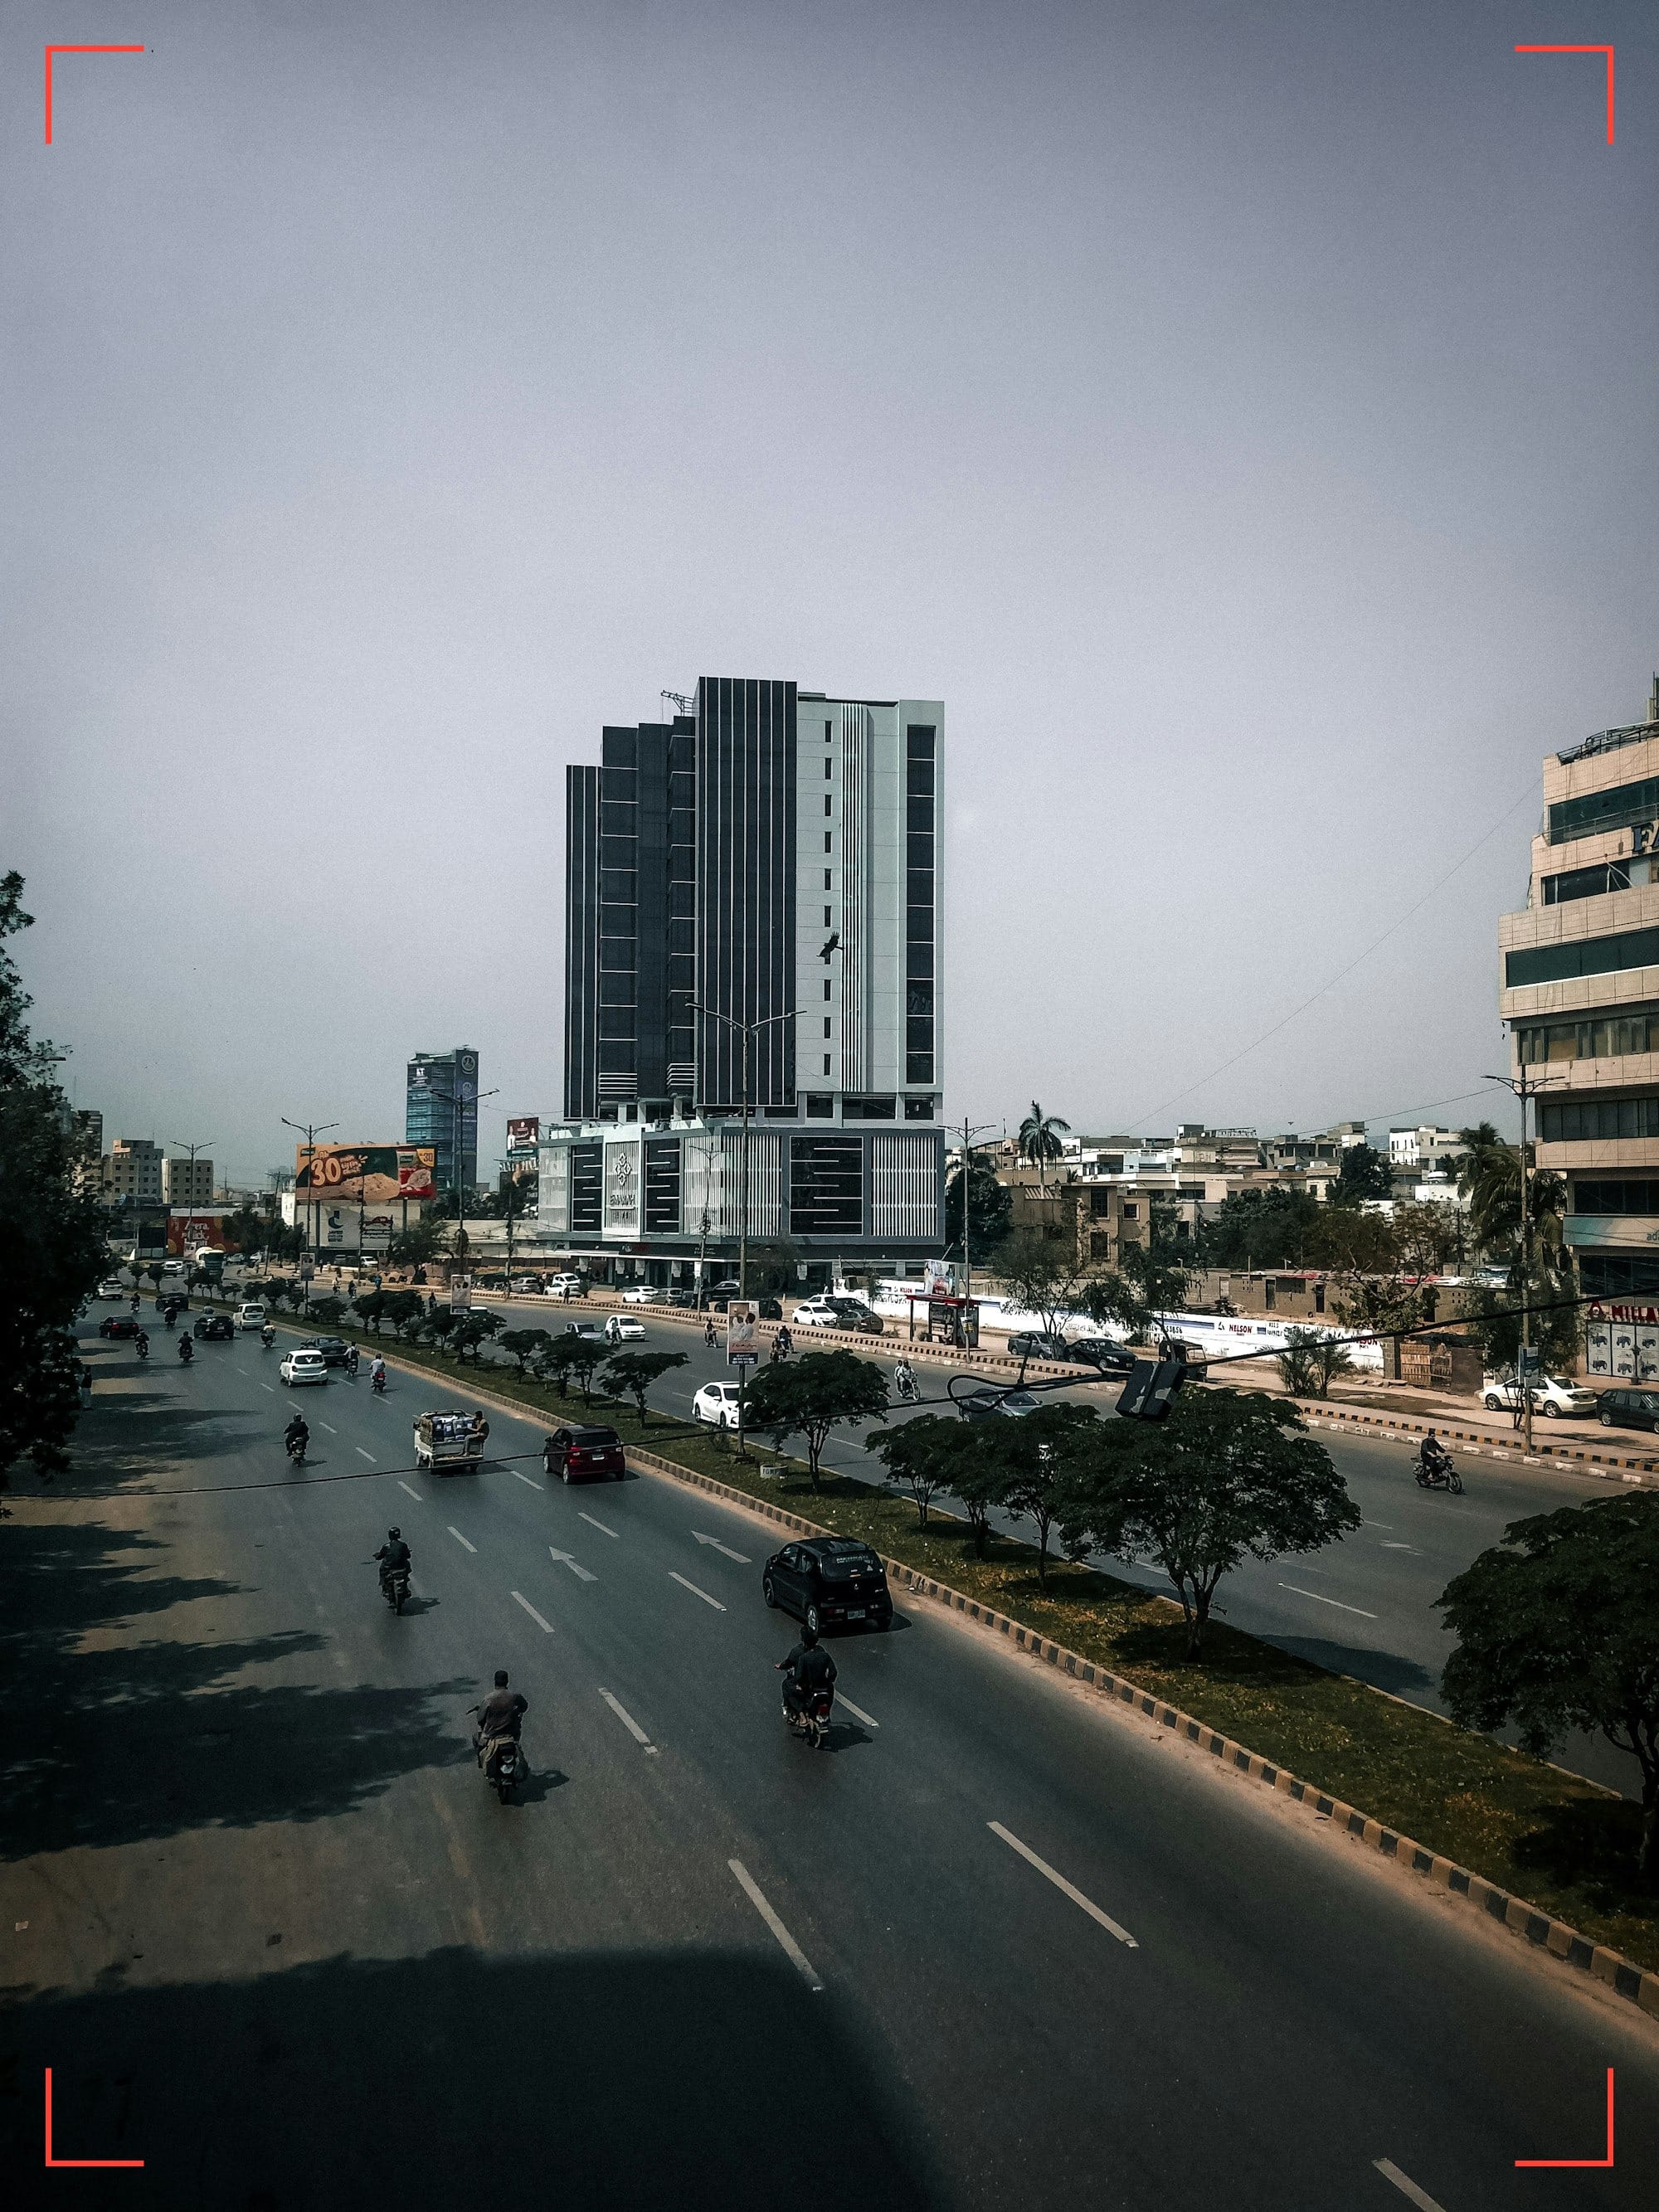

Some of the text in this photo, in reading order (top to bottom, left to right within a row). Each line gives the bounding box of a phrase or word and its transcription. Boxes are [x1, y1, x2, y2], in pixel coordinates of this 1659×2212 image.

[311, 1157, 342, 1186] 30
[1611, 1305, 1659, 1323] MILLA
[1228, 1324, 1253, 1334] NELSON
